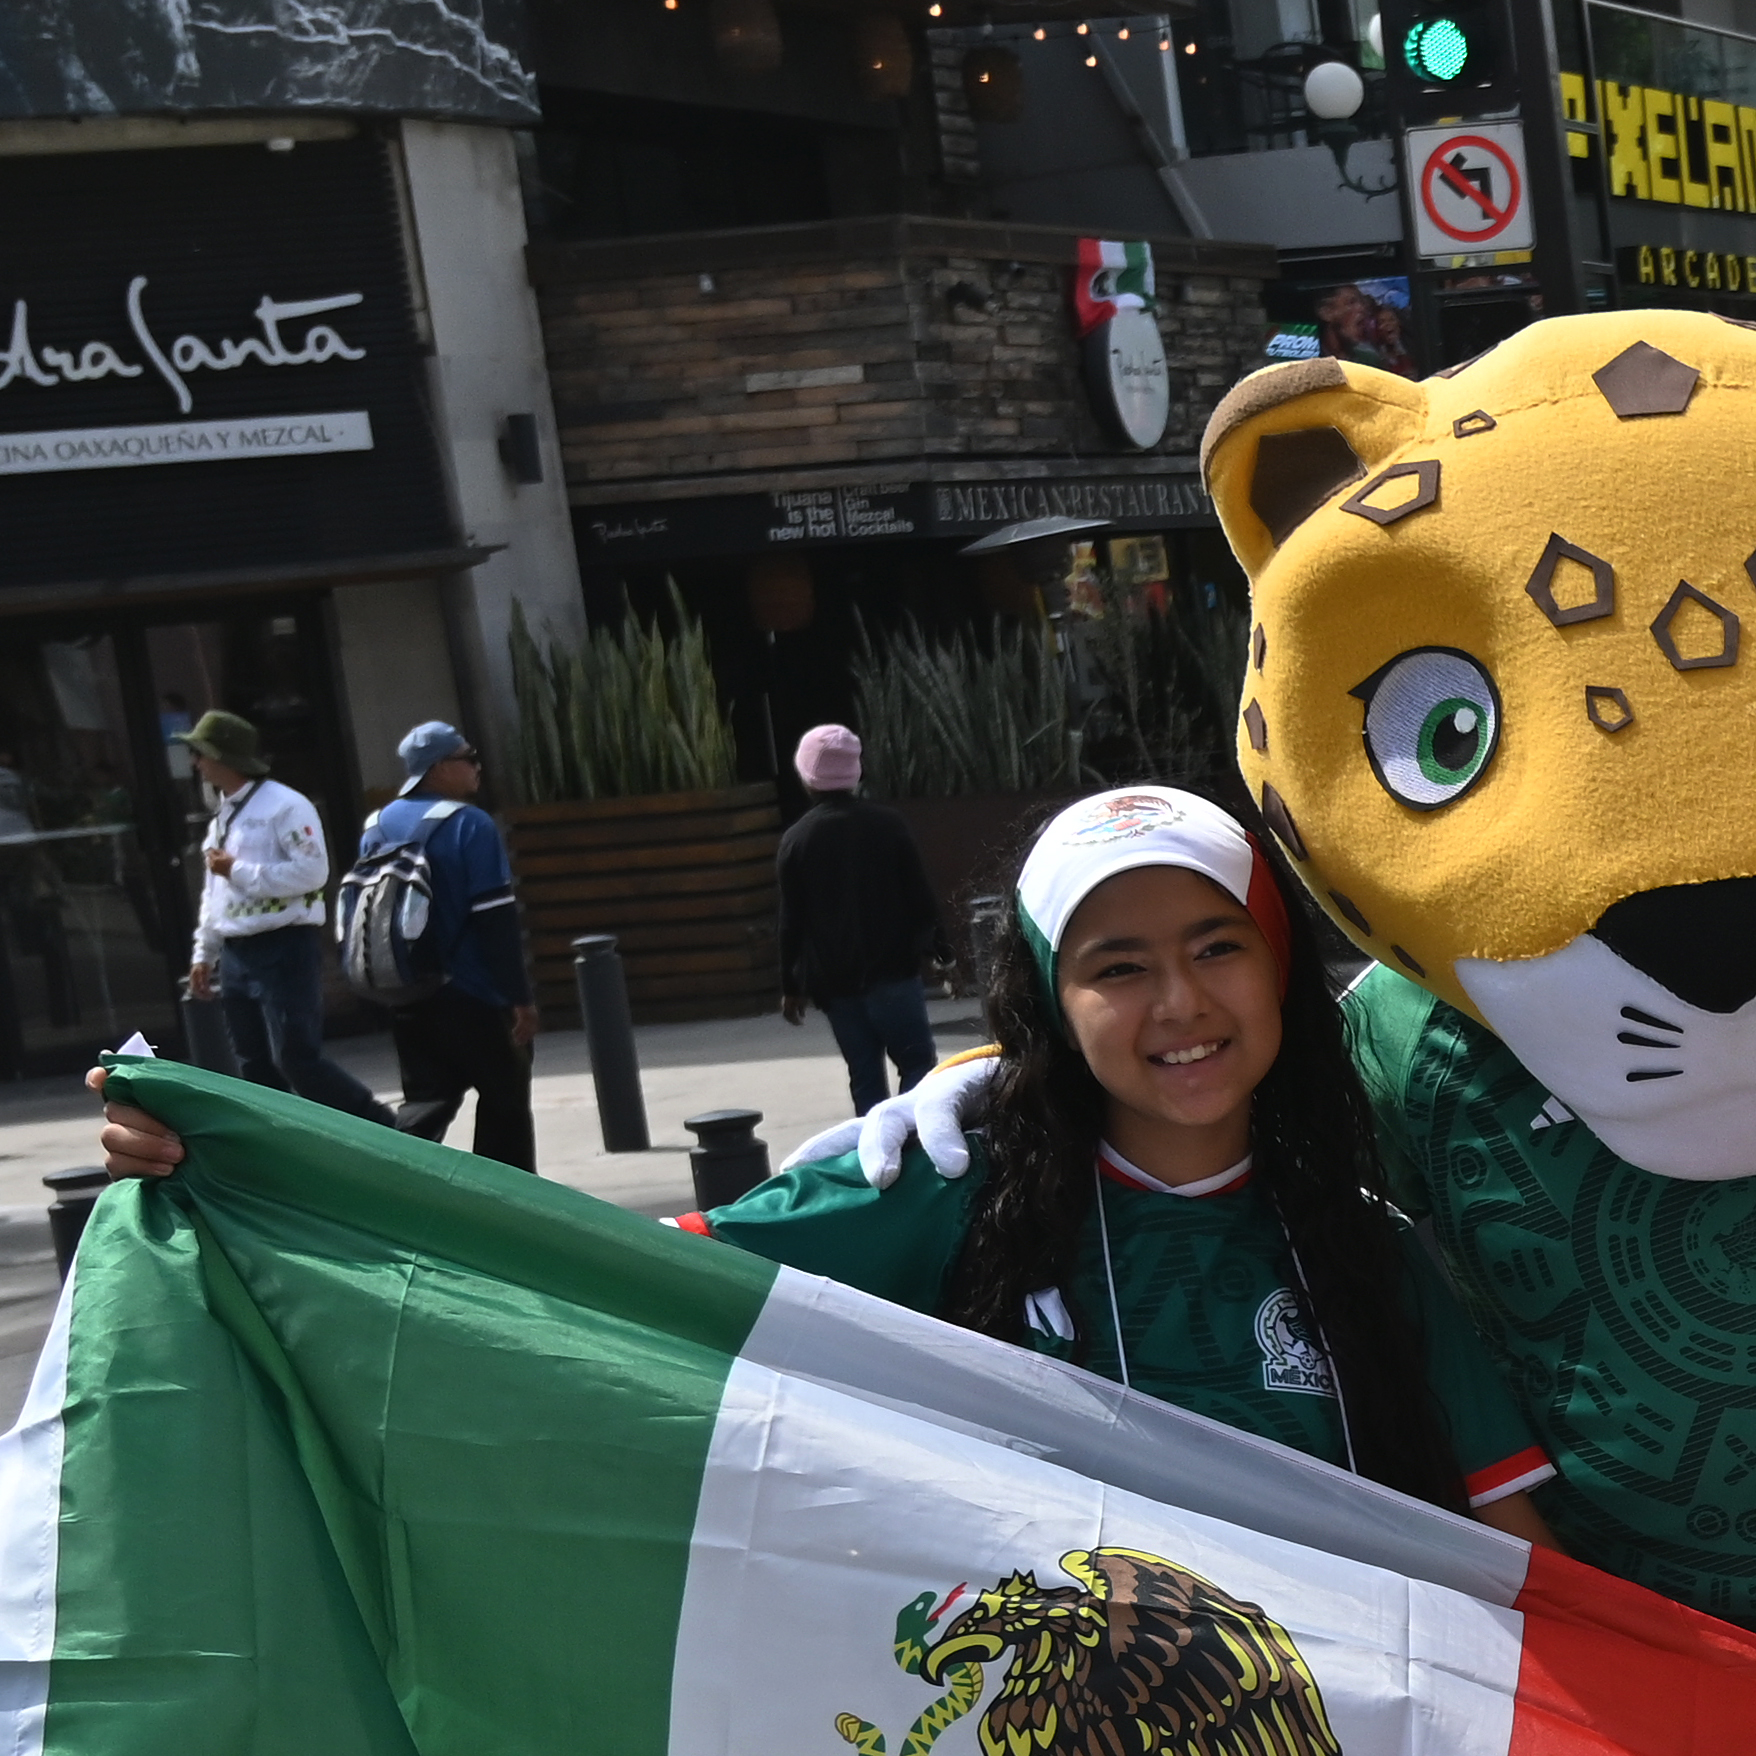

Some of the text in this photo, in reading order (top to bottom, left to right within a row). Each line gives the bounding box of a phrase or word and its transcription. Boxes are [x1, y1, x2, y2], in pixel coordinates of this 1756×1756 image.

[127, 274, 367, 414] Santa
[55, 429, 209, 460] OAXAQUEÑA
[216, 431, 232, 449] Y
[238, 424, 332, 448] MEZCAL
[769, 526, 805, 542] new
[1270, 1365, 1332, 1390] MÉXIC
